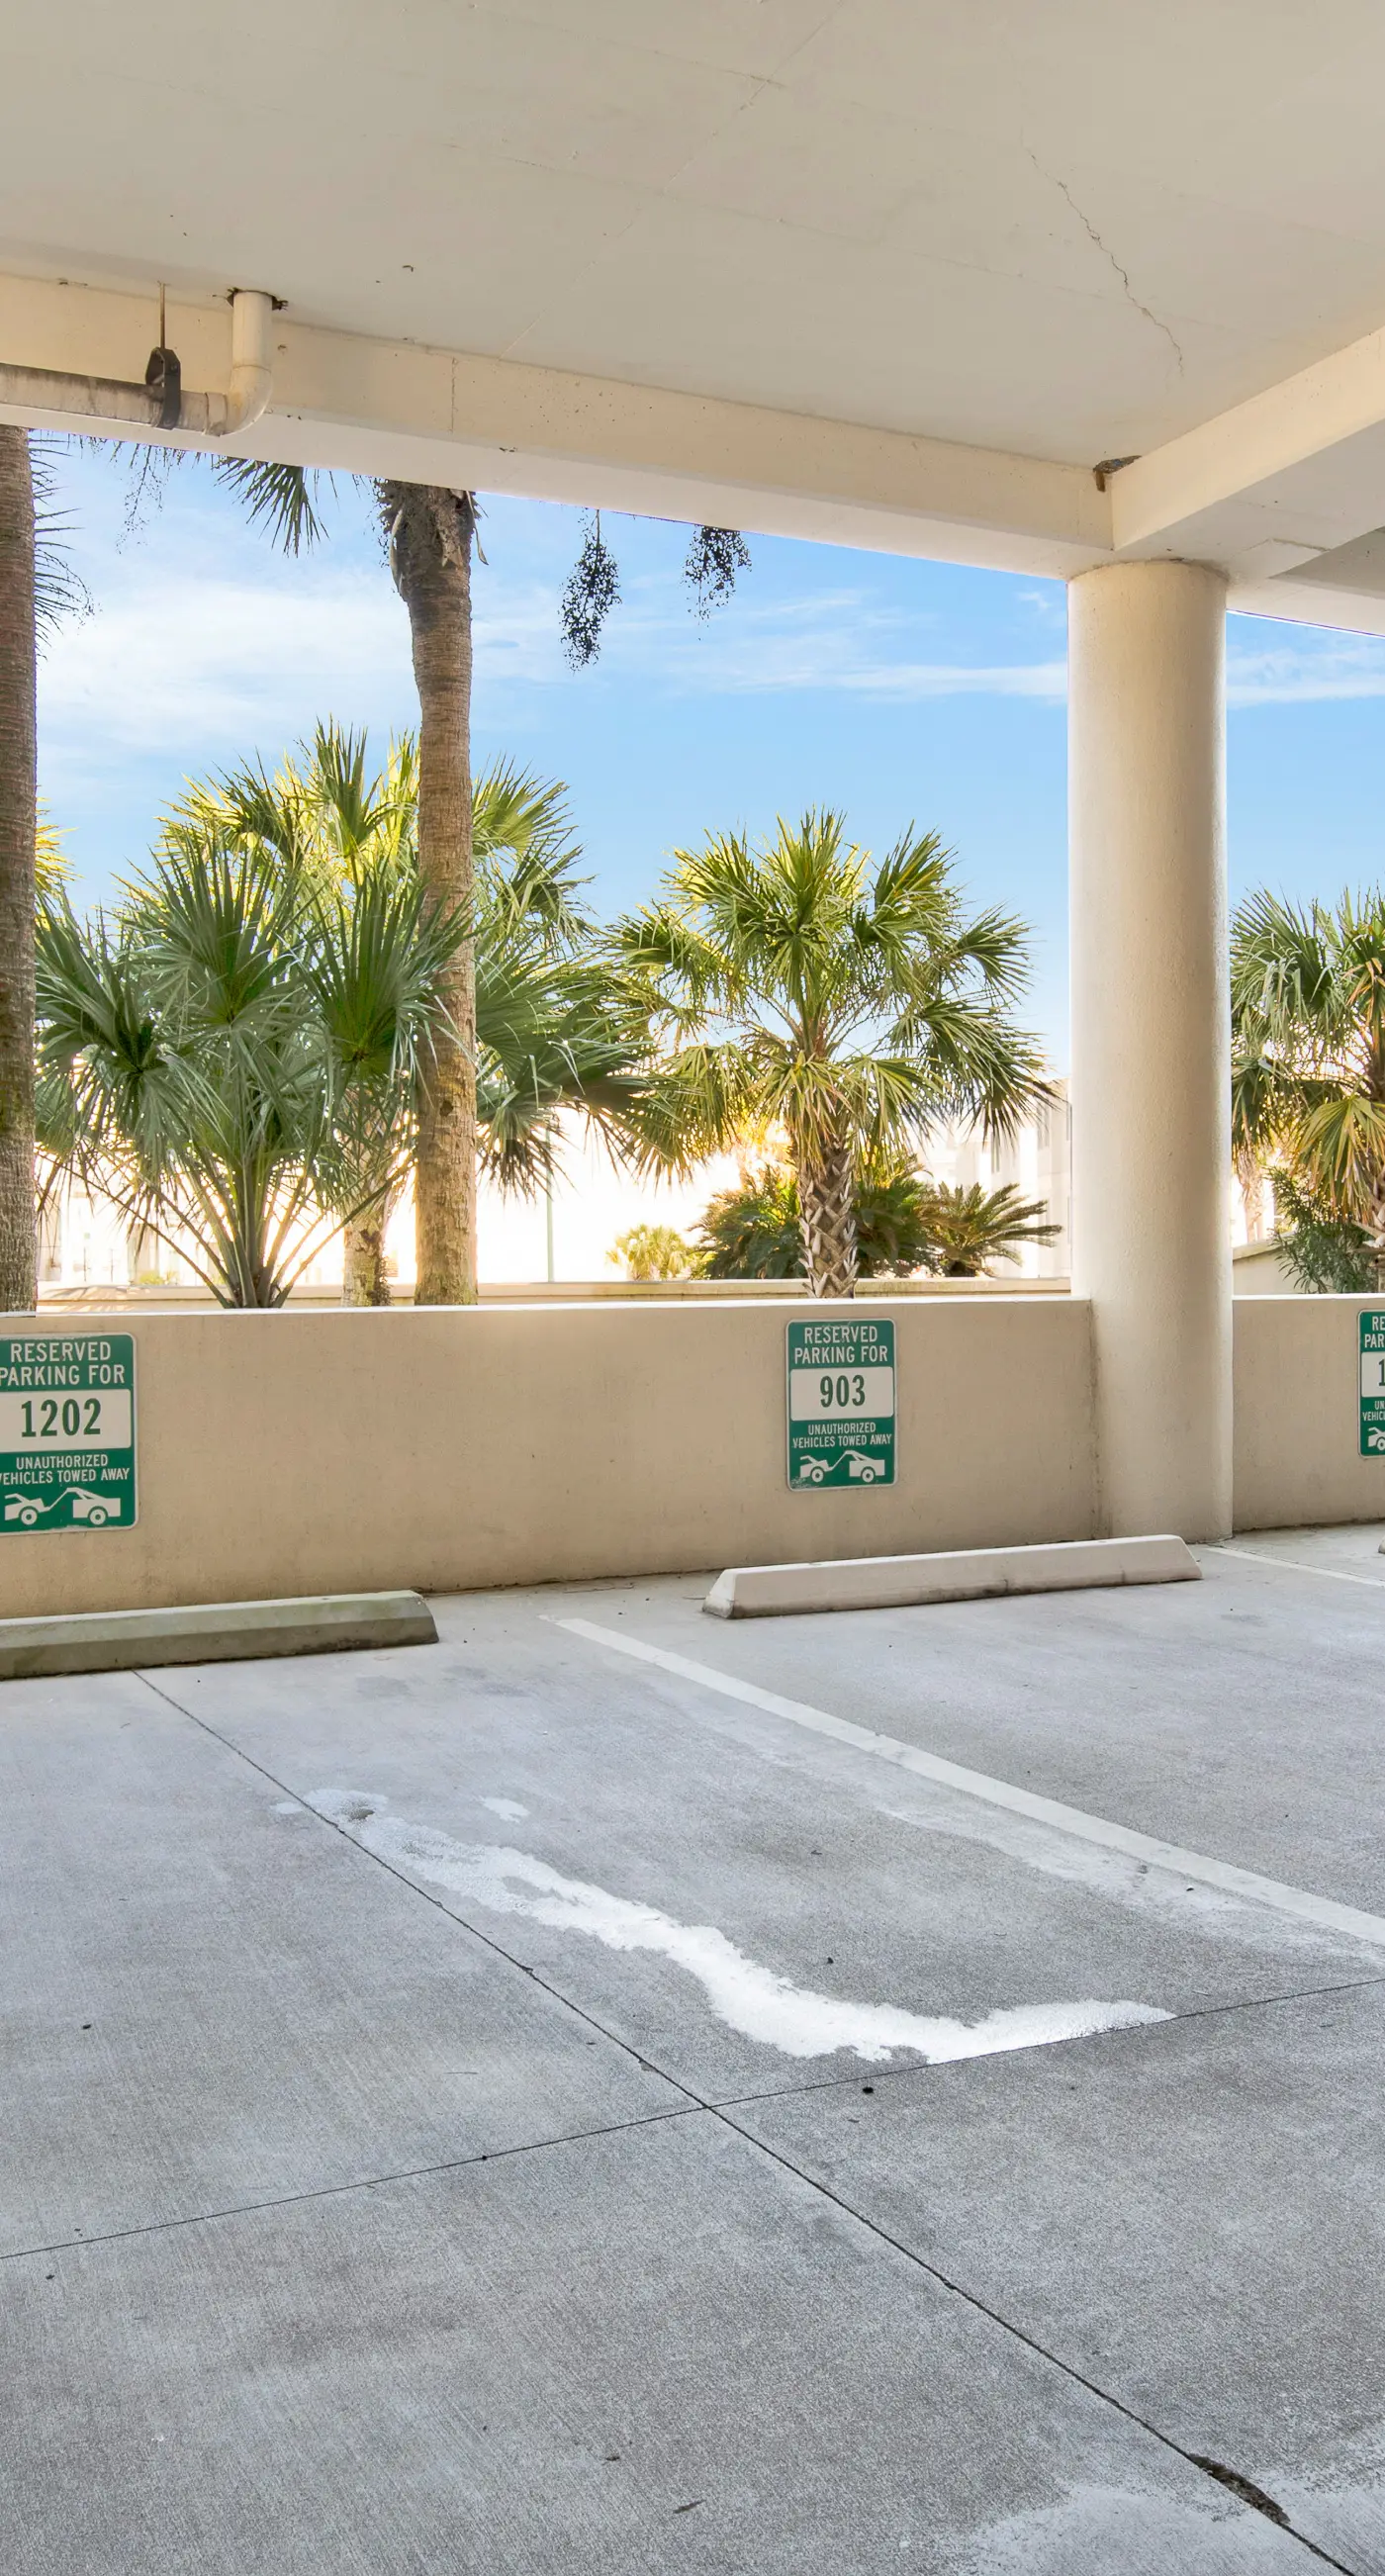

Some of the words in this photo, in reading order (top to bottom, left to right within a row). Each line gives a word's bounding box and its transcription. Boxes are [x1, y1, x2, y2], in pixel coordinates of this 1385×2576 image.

[804, 1326, 878, 1343] RESERVED
[11, 1341, 111, 1362] RESERVED
[794, 1345, 855, 1364] PARKING
[861, 1345, 887, 1362] FOR
[0, 1365, 80, 1386] PARKING
[89, 1364, 125, 1384] FOR
[820, 1374, 866, 1408] 903
[21, 1398, 101, 1437] 1202
[807, 1423, 877, 1435] UNAUTHORIZED
[792, 1435, 836, 1448] VEHICLES
[838, 1434, 867, 1446] TOWED
[871, 1433, 892, 1445] AWAY
[16, 1454, 109, 1470] UNAUTHORIZED
[57, 1469, 96, 1483] TOWED
[101, 1467, 130, 1481] AWAY
